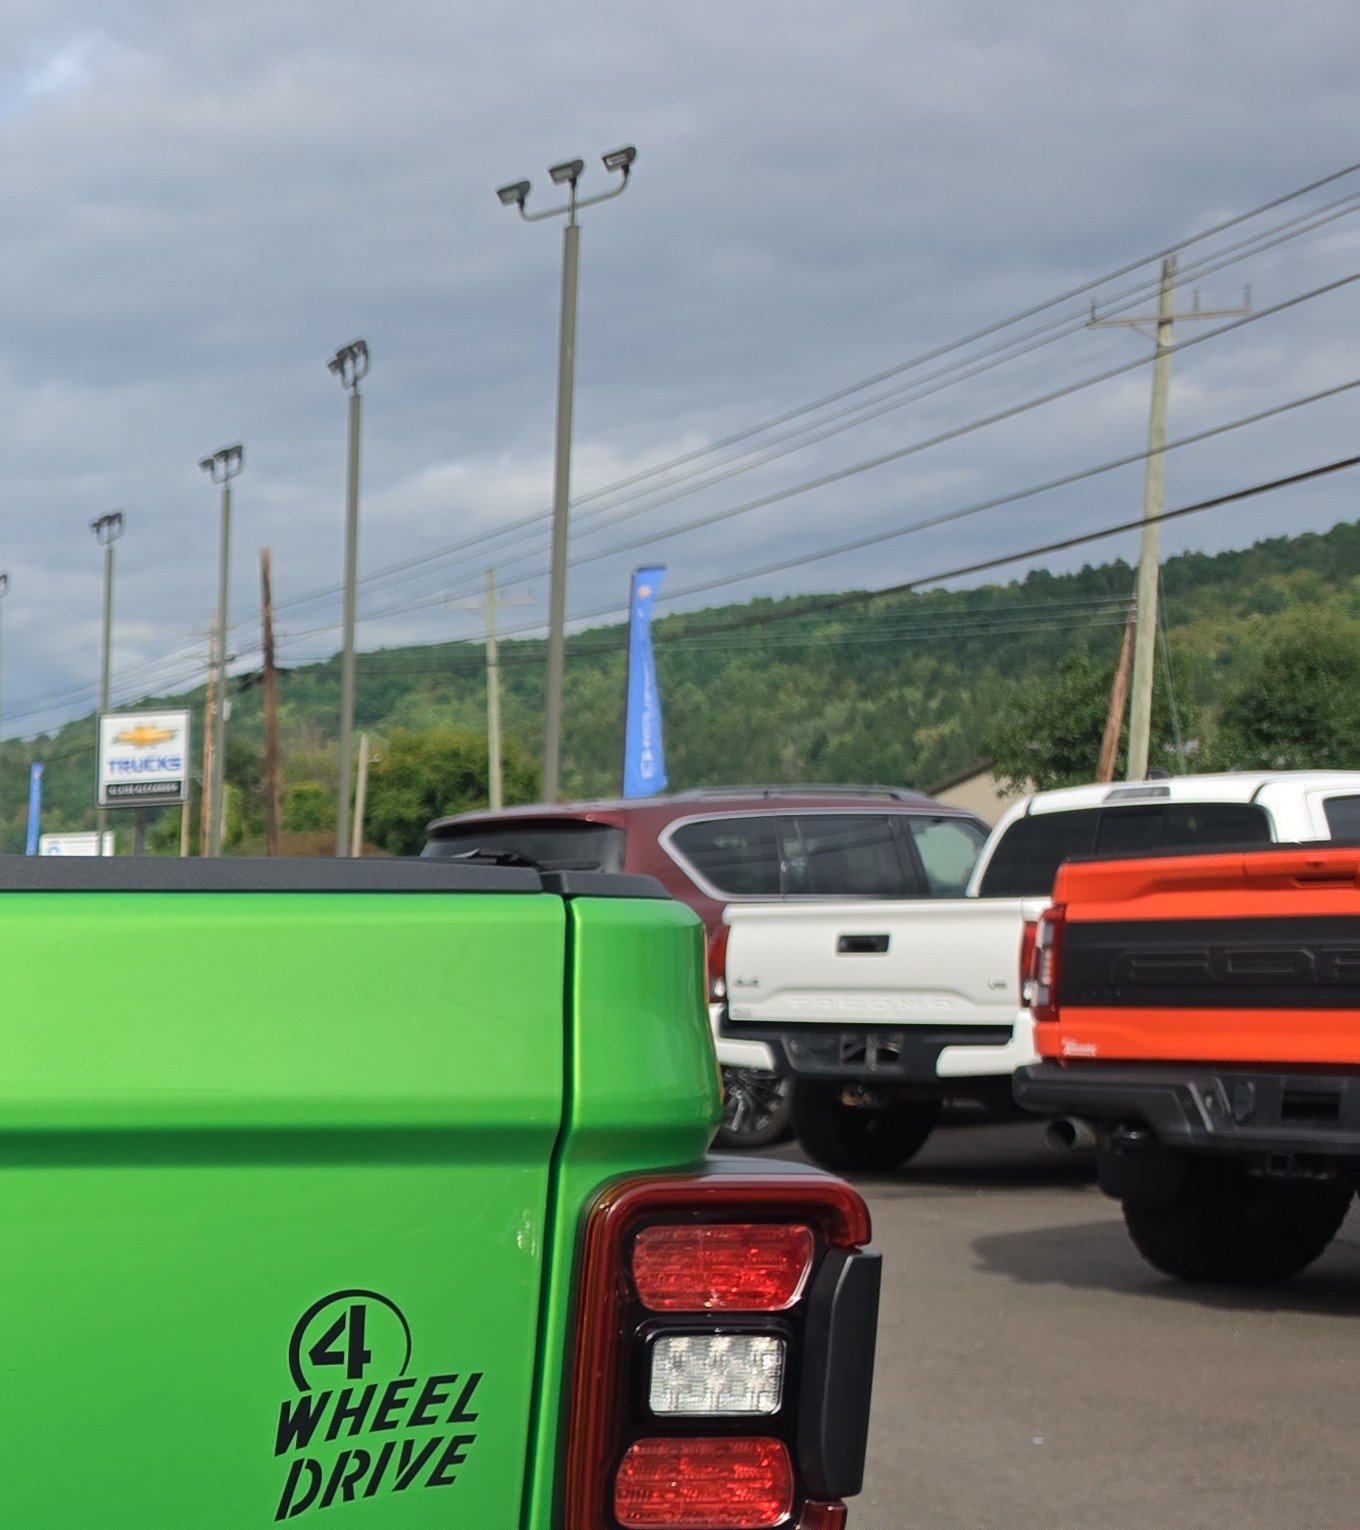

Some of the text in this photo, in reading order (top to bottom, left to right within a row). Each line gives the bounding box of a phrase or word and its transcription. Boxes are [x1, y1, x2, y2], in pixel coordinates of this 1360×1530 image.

[107, 757, 182, 774] TRUCKS
[308, 1305, 372, 1379] 4
[274, 1372, 484, 1457] WHEEL
[274, 1434, 477, 1522] DRIVE
